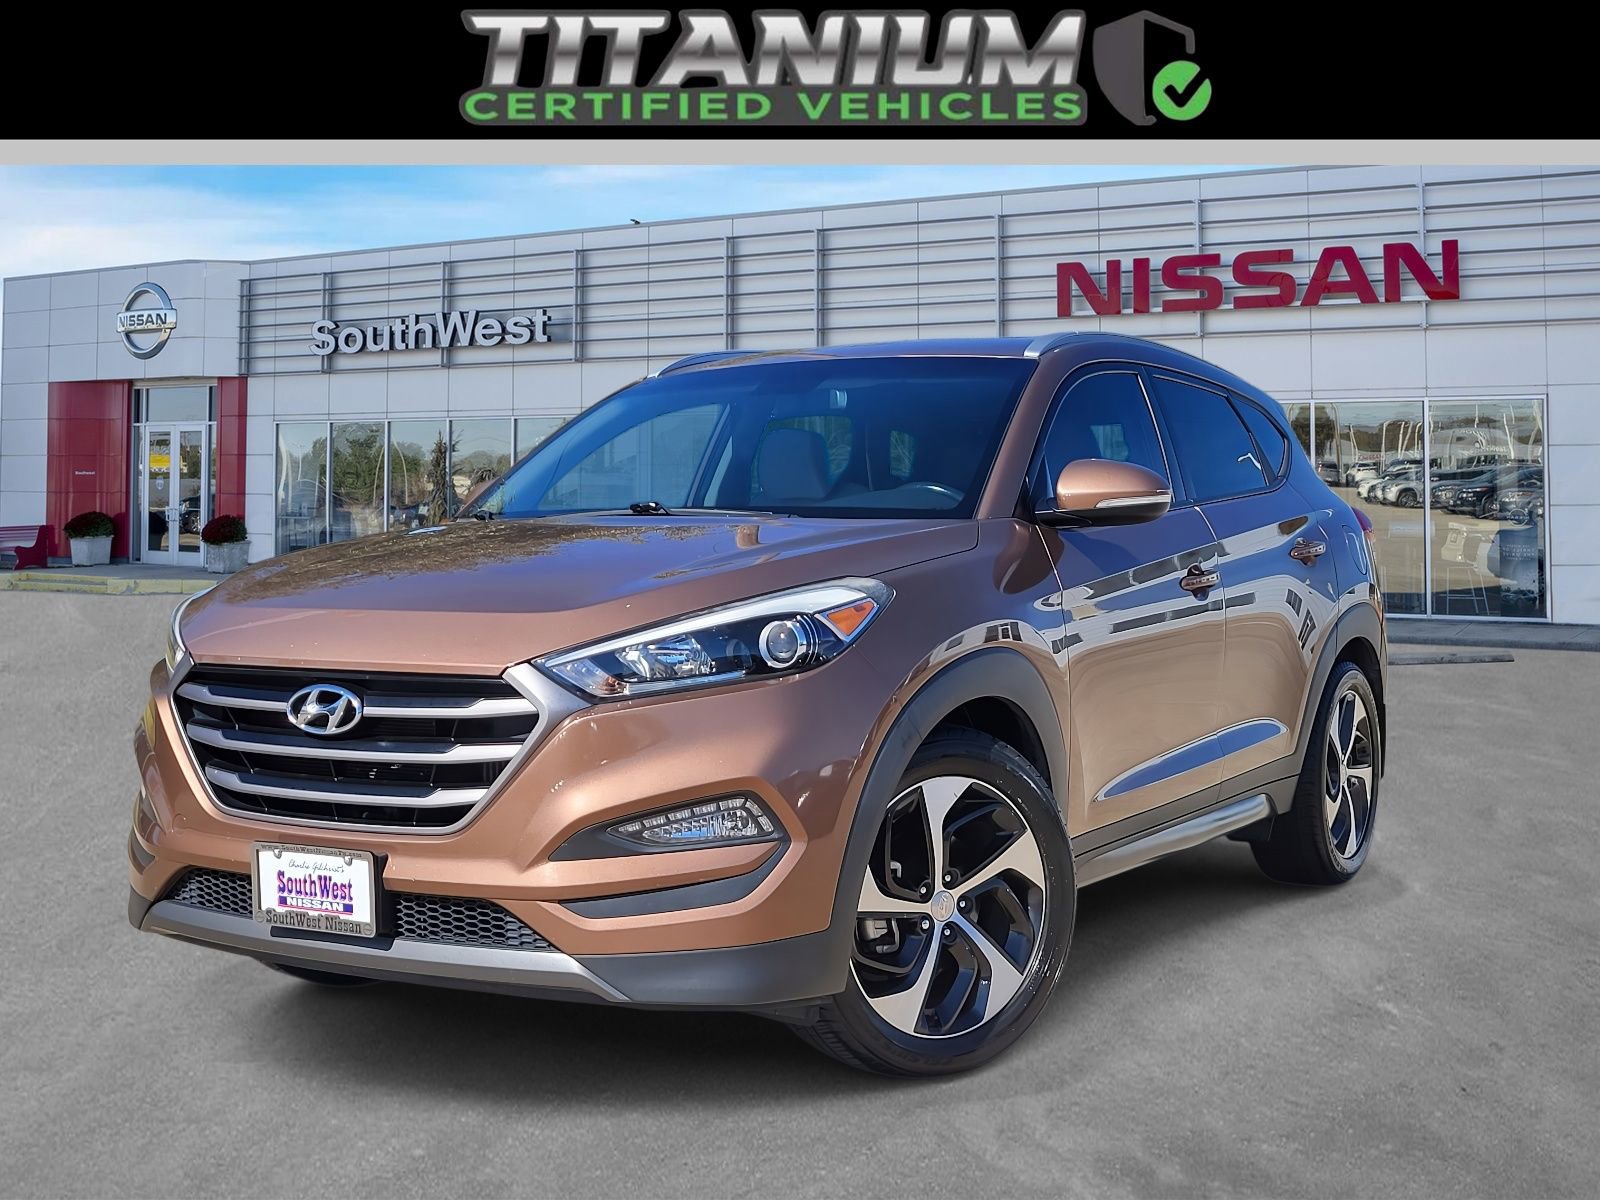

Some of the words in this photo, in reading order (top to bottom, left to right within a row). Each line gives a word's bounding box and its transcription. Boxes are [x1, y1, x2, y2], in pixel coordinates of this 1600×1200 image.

[1056, 239, 1461, 318] NISSAN
[119, 312, 168, 328] NISSAN
[309, 309, 552, 356] SouthWest
[277, 869, 354, 902] SouthWest
[286, 896, 344, 912] NISSAN
[265, 908, 322, 929] SouthWest
[325, 915, 362, 935] Nissan
